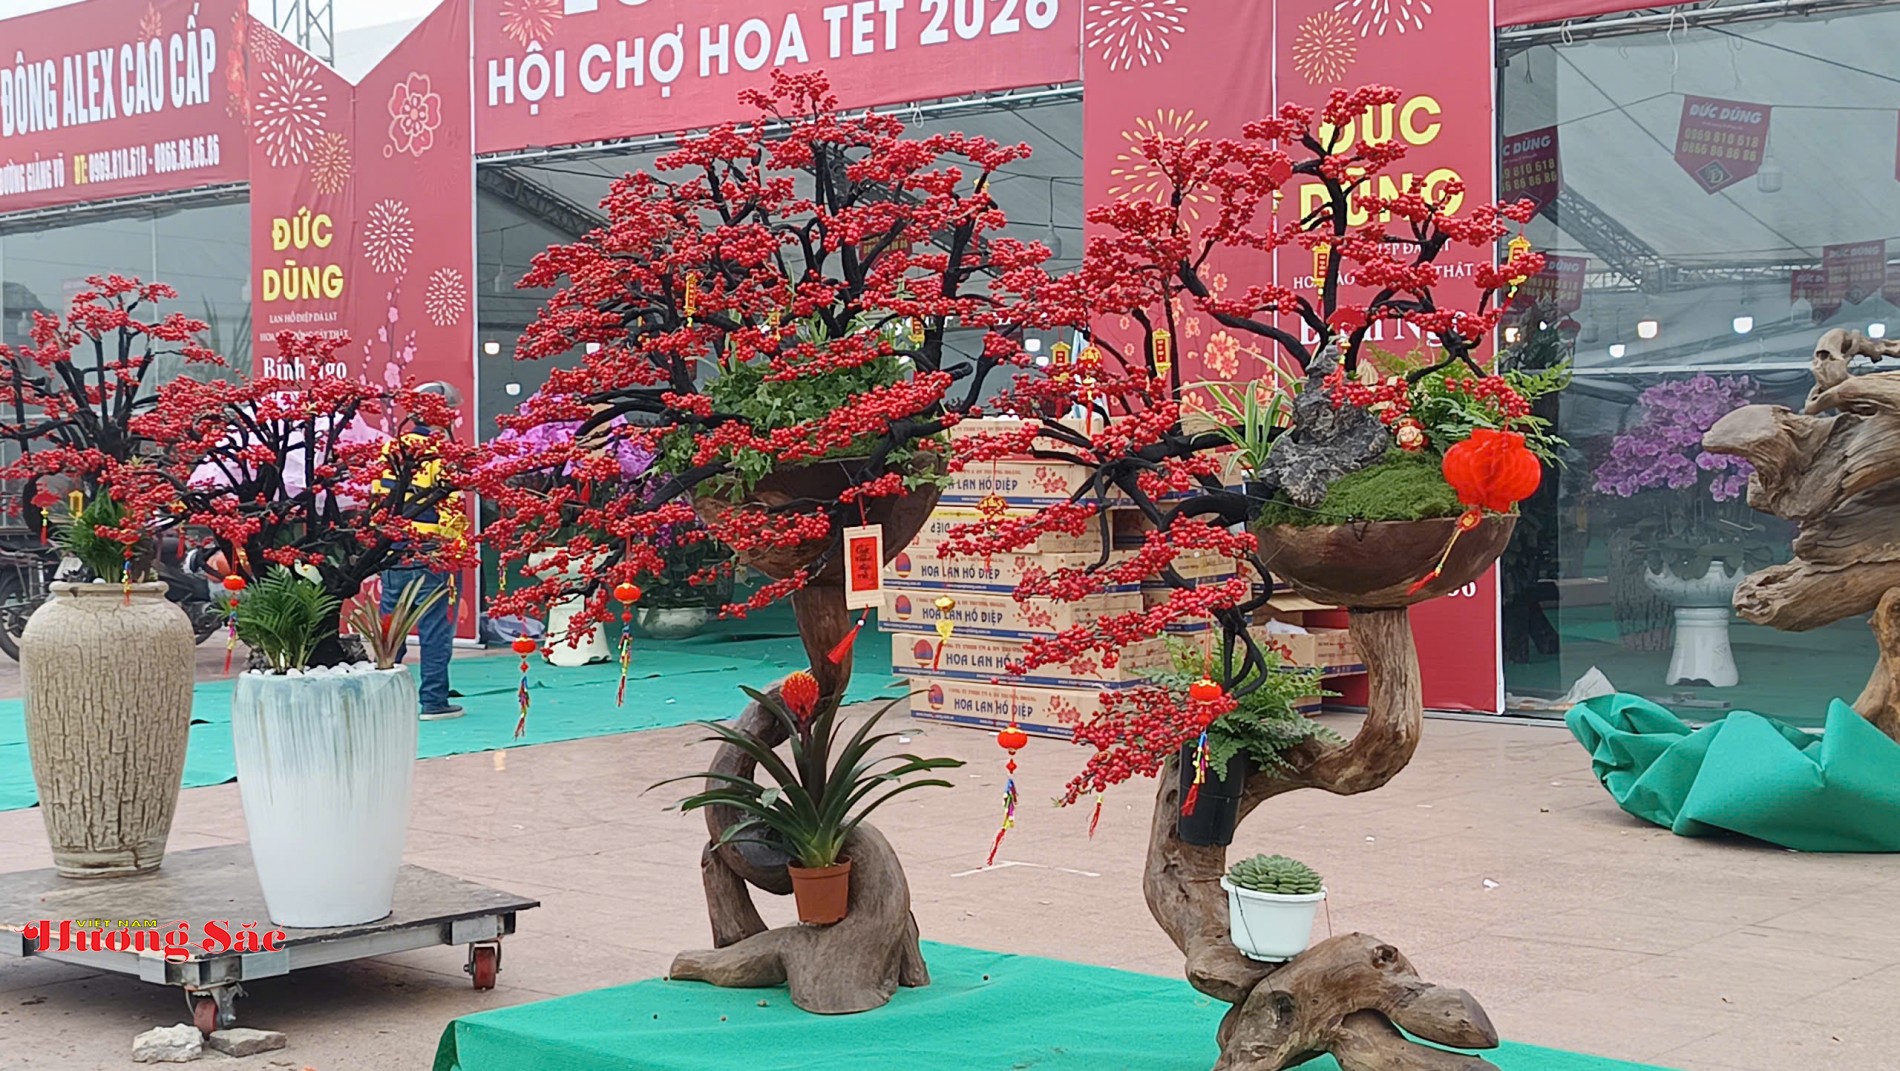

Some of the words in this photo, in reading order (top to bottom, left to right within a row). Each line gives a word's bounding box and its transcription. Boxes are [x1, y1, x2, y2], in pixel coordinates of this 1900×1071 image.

[63, 48, 116, 126] ALEX
[120, 38, 164, 117] CAO
[170, 3, 216, 108] CẤP
[488, 40, 565, 116] HỘI
[579, 23, 683, 98] CHỢ
[700, 13, 809, 77] HOA
[920, 0, 1058, 45] 2026
[272, 206, 333, 251] ĐỨC
[263, 259, 344, 301] DŨNG
[957, 479, 975, 491] LAN
[995, 477, 1018, 493] ĐIỆP
[921, 565, 939, 578] HOA
[942, 566, 959, 578] LAN
[922, 608, 941, 620] HOA
[946, 653, 968, 666] HOA
[972, 655, 993, 667] LAN
[954, 698, 973, 711] HOA
[975, 700, 993, 713] LAN
